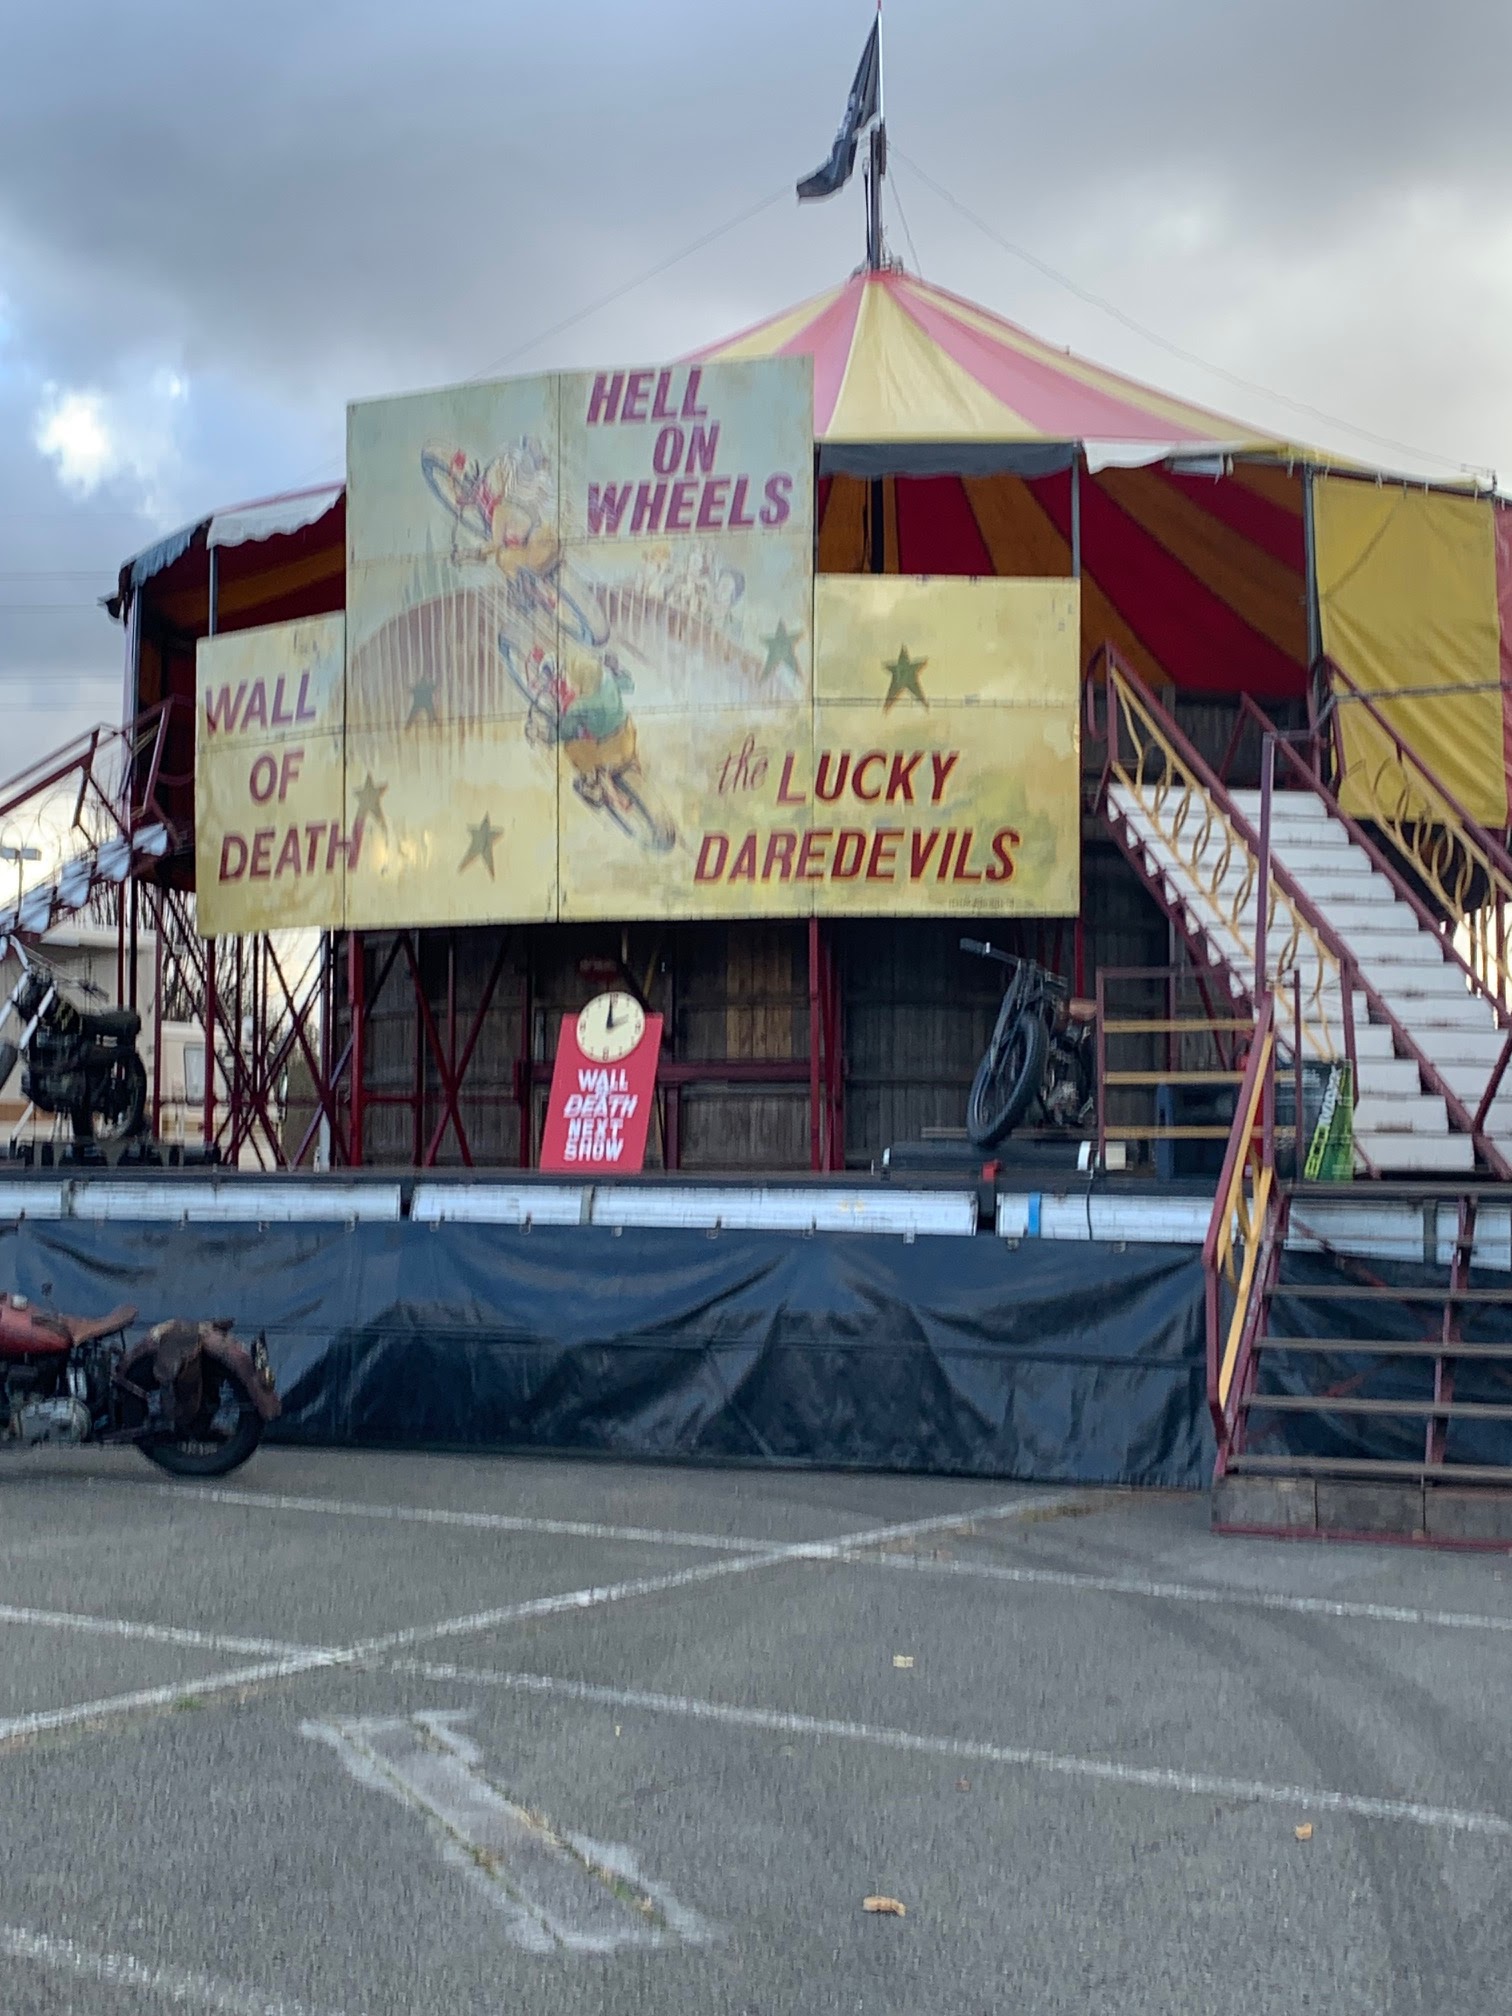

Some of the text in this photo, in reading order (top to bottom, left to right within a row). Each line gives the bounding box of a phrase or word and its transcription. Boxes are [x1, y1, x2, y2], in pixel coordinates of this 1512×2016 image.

[586, 367, 708, 427] HELL
[653, 419, 720, 478] ON
[587, 471, 794, 537] WHEELS
[205, 670, 316, 736] WALL
[249, 748, 304, 804] OF
[716, 732, 960, 806] the LUCKY
[218, 812, 366, 884] DEATH
[693, 826, 1021, 885] DAREDEVILS
[563, 1094, 639, 1119] DEATH
[578, 1068, 629, 1092] WALL
[563, 1138, 624, 1162] SHOW
[567, 1118, 624, 1141] NEXT
